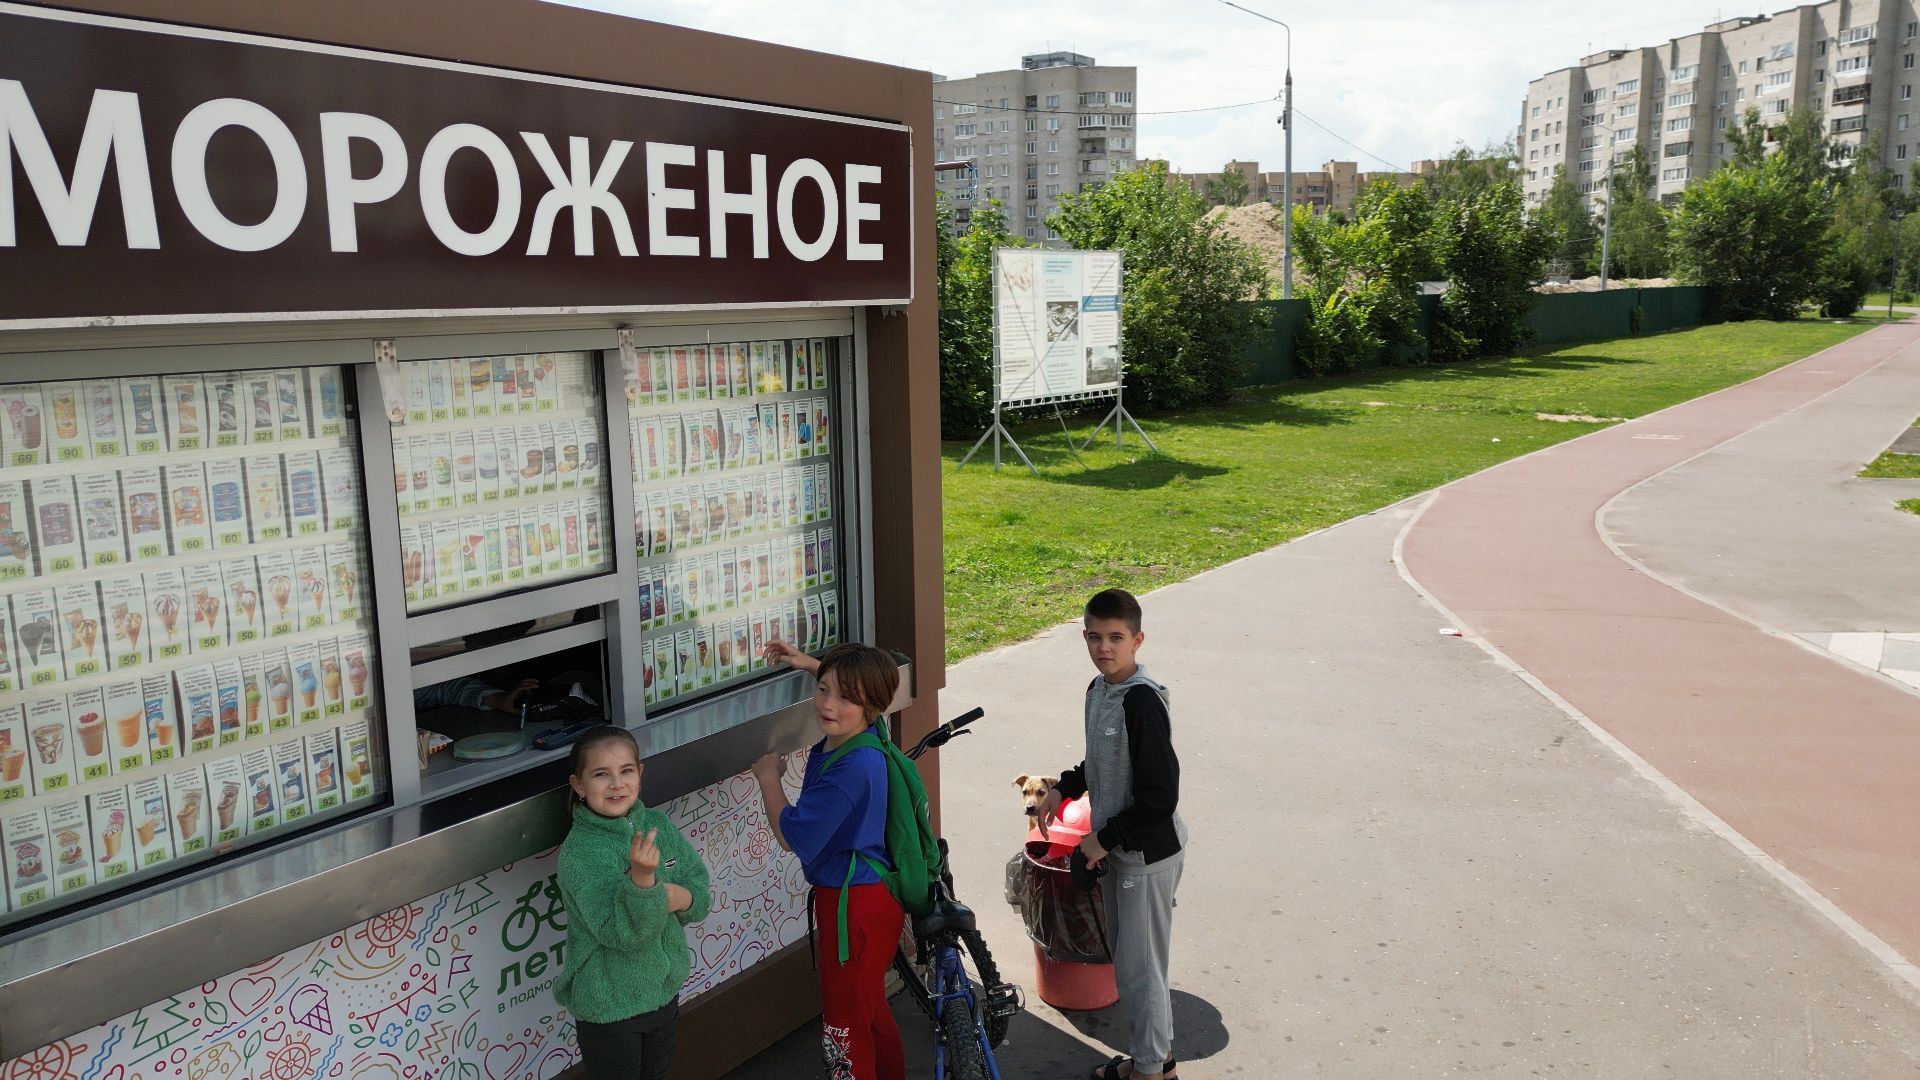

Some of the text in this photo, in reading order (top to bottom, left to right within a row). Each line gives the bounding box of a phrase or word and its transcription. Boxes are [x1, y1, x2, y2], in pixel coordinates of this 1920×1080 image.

[0, 79, 884, 262] МОРОЖЕНОЕ
[256, 432, 272, 441] 321
[284, 429, 301, 437] 321
[179, 438, 197, 448] 321
[218, 435, 237, 445] 321
[100, 444, 115, 454] 65
[140, 441, 154, 451] 99
[64, 448, 78, 458] 90
[18, 454, 32, 464] 69
[399, 504, 407, 512] 3
[300, 524, 317, 532] 112
[336, 519, 351, 527] 130
[262, 528, 280, 537] 130
[225, 535, 237, 543] 60
[186, 540, 200, 549] 60
[144, 546, 157, 556] 60
[99, 553, 113, 563] 60
[55, 560, 70, 569] 60
[2, 565, 25, 577] 146
[342, 610, 354, 619] 50
[309, 616, 321, 626] 50
[276, 625, 288, 634] 50
[241, 631, 253, 640] 50
[203, 638, 216, 648] 50
[164, 646, 177, 656] 50
[123, 654, 137, 665] 50
[80, 662, 95, 673] 50
[36, 672, 52, 683] 68
[0, 679, 6, 690] 5
[354, 698, 365, 708] 43
[329, 704, 340, 714] 43
[305, 711, 316, 721] 43
[275, 718, 286, 728] 43
[248, 726, 260, 735] 43
[222, 733, 234, 744] 33
[196, 741, 209, 751] 33
[156, 749, 170, 760] 33
[125, 757, 138, 768] 31
[89, 766, 103, 777] 41
[49, 777, 63, 788] 37
[3, 787, 19, 799] 25
[356, 786, 367, 797] 99
[322, 796, 334, 807] 92
[290, 807, 301, 817] 92
[259, 818, 271, 828] 92
[223, 830, 236, 840] 72
[187, 840, 200, 850] 72
[149, 851, 162, 862] 72
[109, 863, 123, 874] 72
[69, 878, 82, 888] 61
[26, 891, 40, 902] 61
